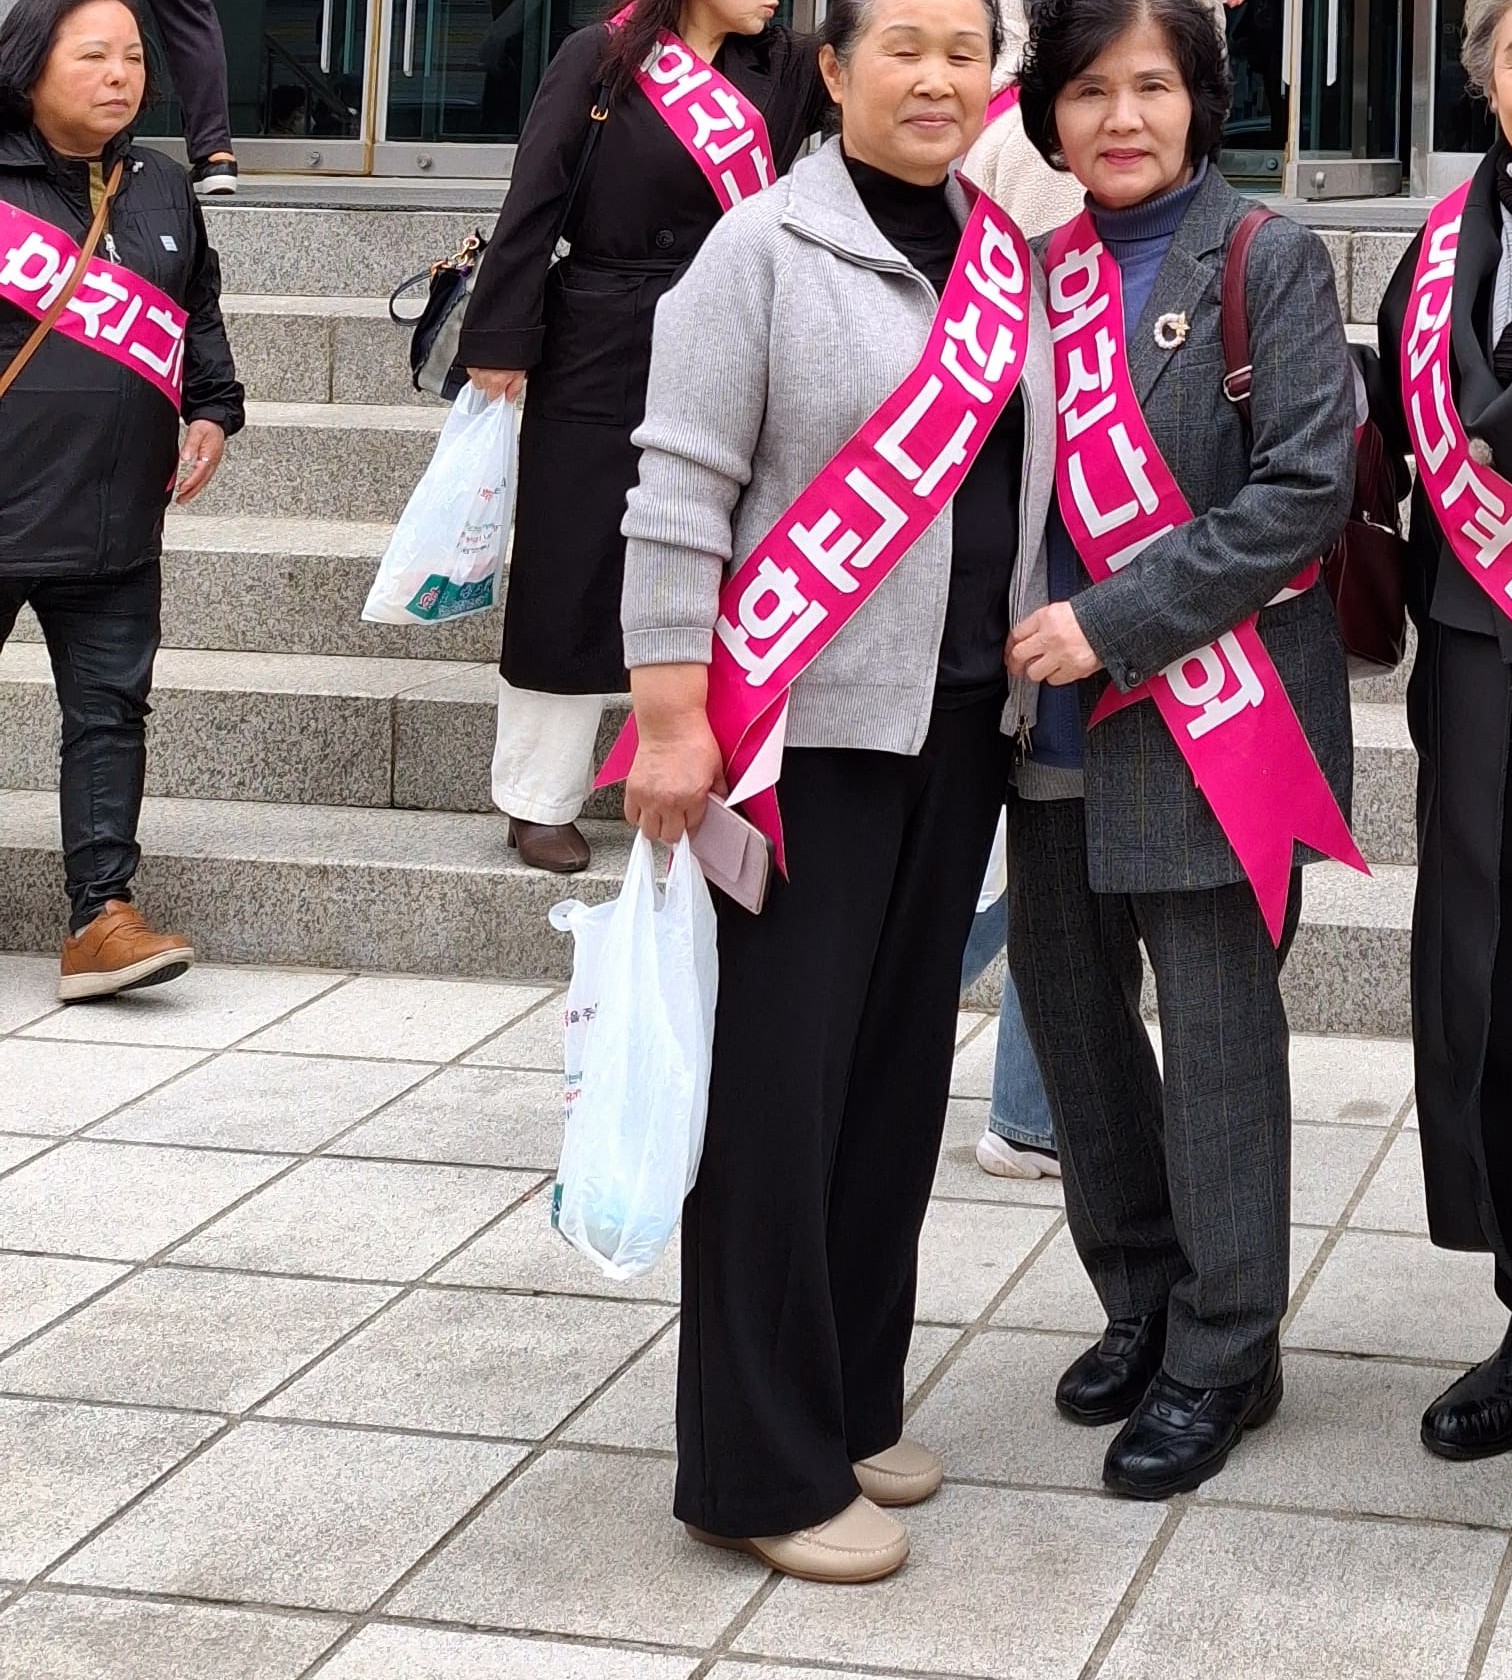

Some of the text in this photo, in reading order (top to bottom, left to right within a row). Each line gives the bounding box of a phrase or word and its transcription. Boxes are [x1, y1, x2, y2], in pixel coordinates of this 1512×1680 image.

[0, 231, 184, 387] 호산나
[715, 213, 1026, 688] 호산나교회
[1046, 241, 1267, 740] 호산나회
